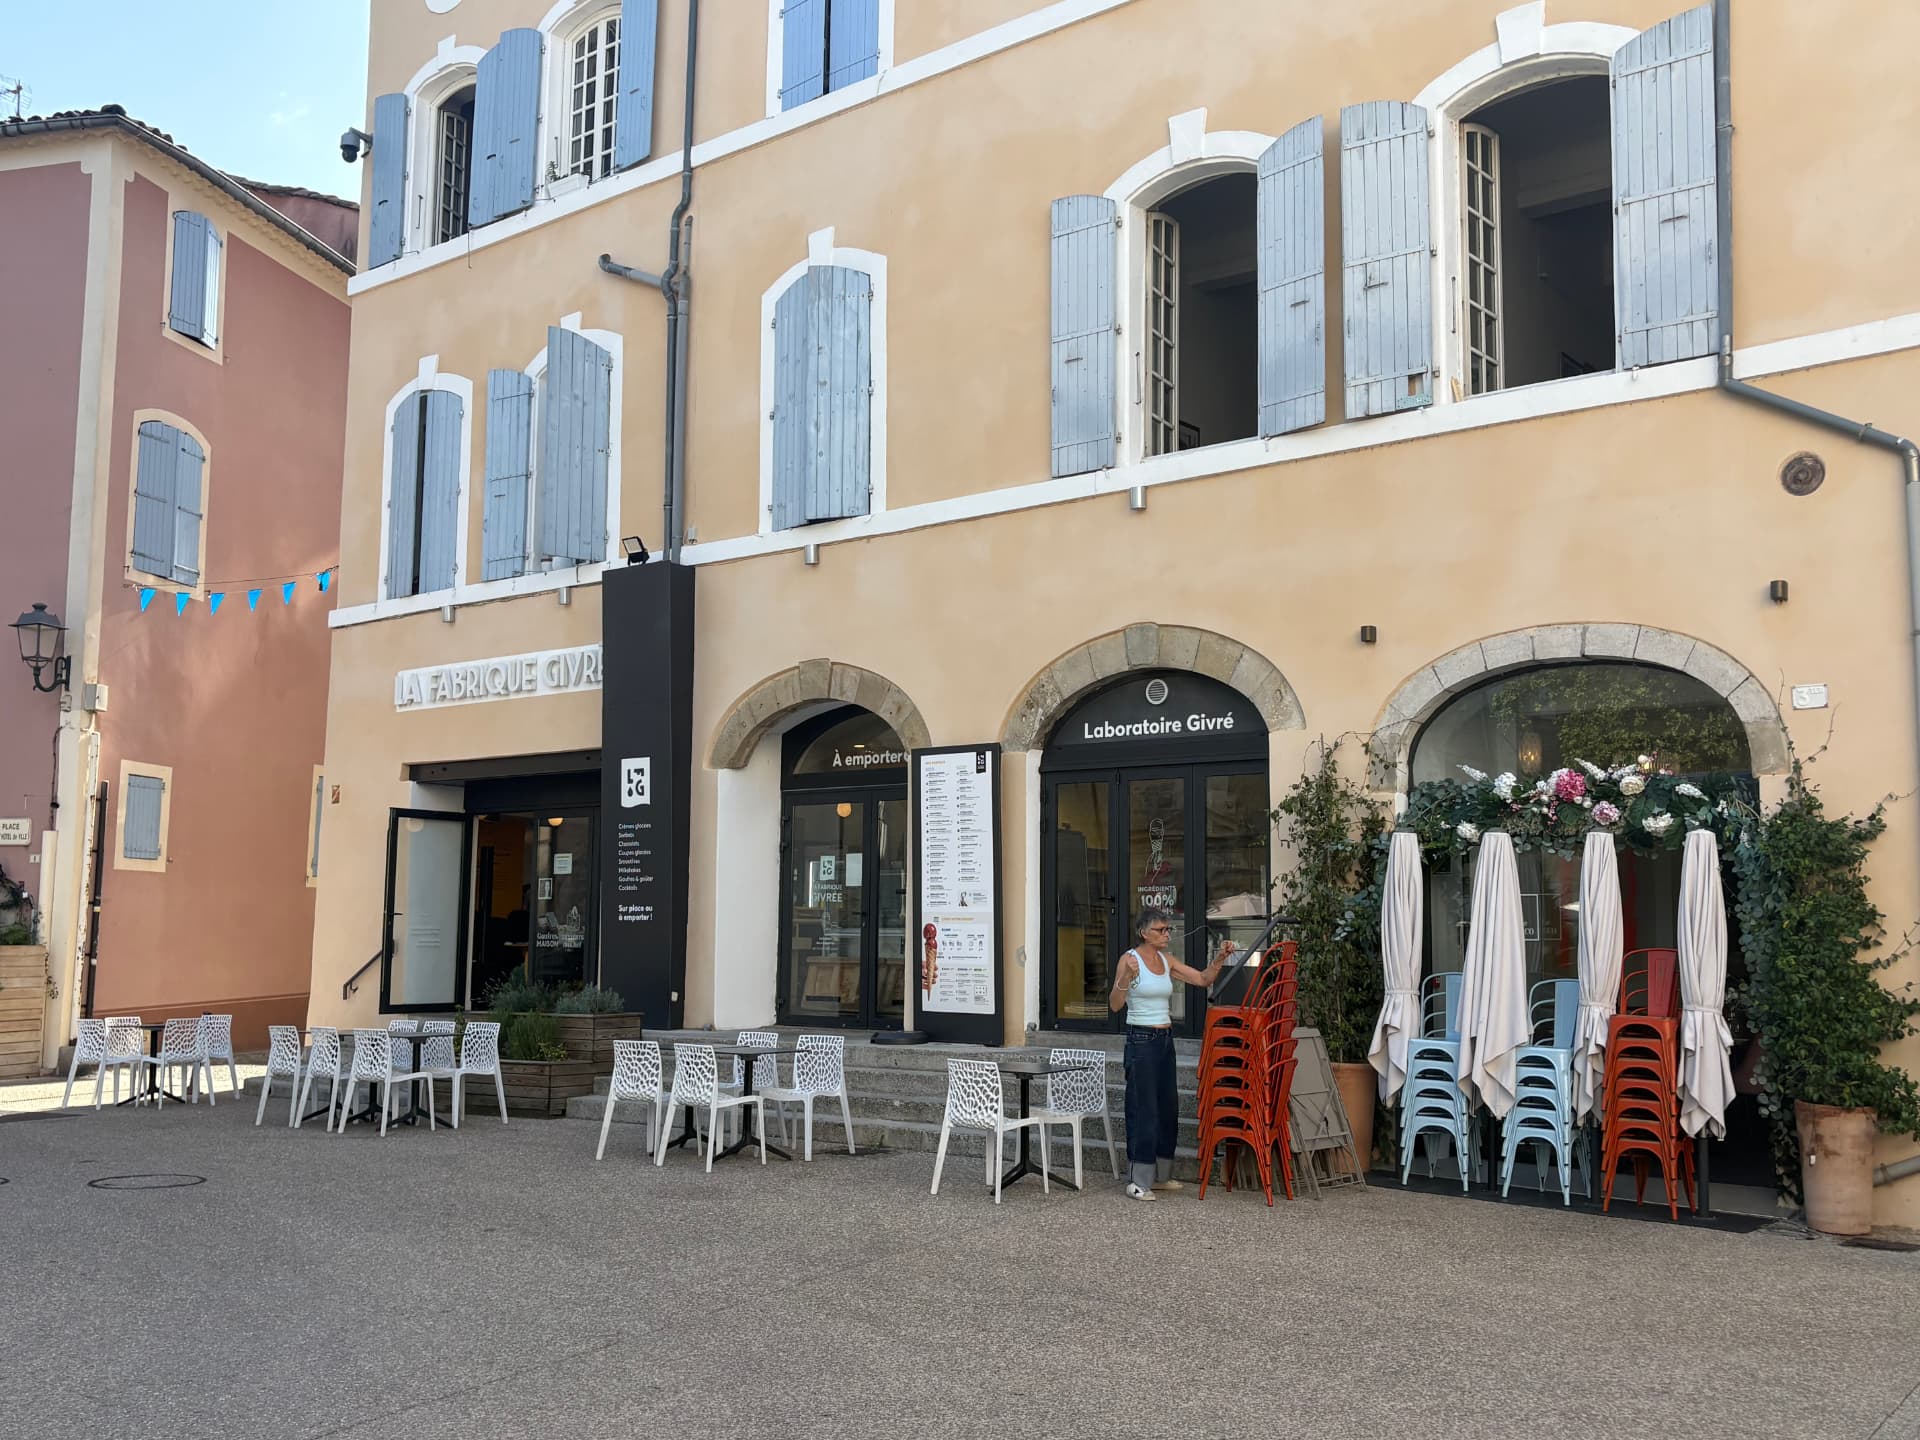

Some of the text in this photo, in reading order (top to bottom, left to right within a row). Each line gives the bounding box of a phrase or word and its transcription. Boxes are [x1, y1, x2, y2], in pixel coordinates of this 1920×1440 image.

[396, 673, 422, 705] LA
[427, 657, 538, 703] FABRIQUE
[1084, 711, 1234, 739] Laboratoire Givré
[832, 749, 903, 769] À emporter
[618, 904, 628, 912] Sur
[628, 904, 644, 913] place
[1141, 894, 1175, 907] 100%
[623, 913, 649, 923] emporter
